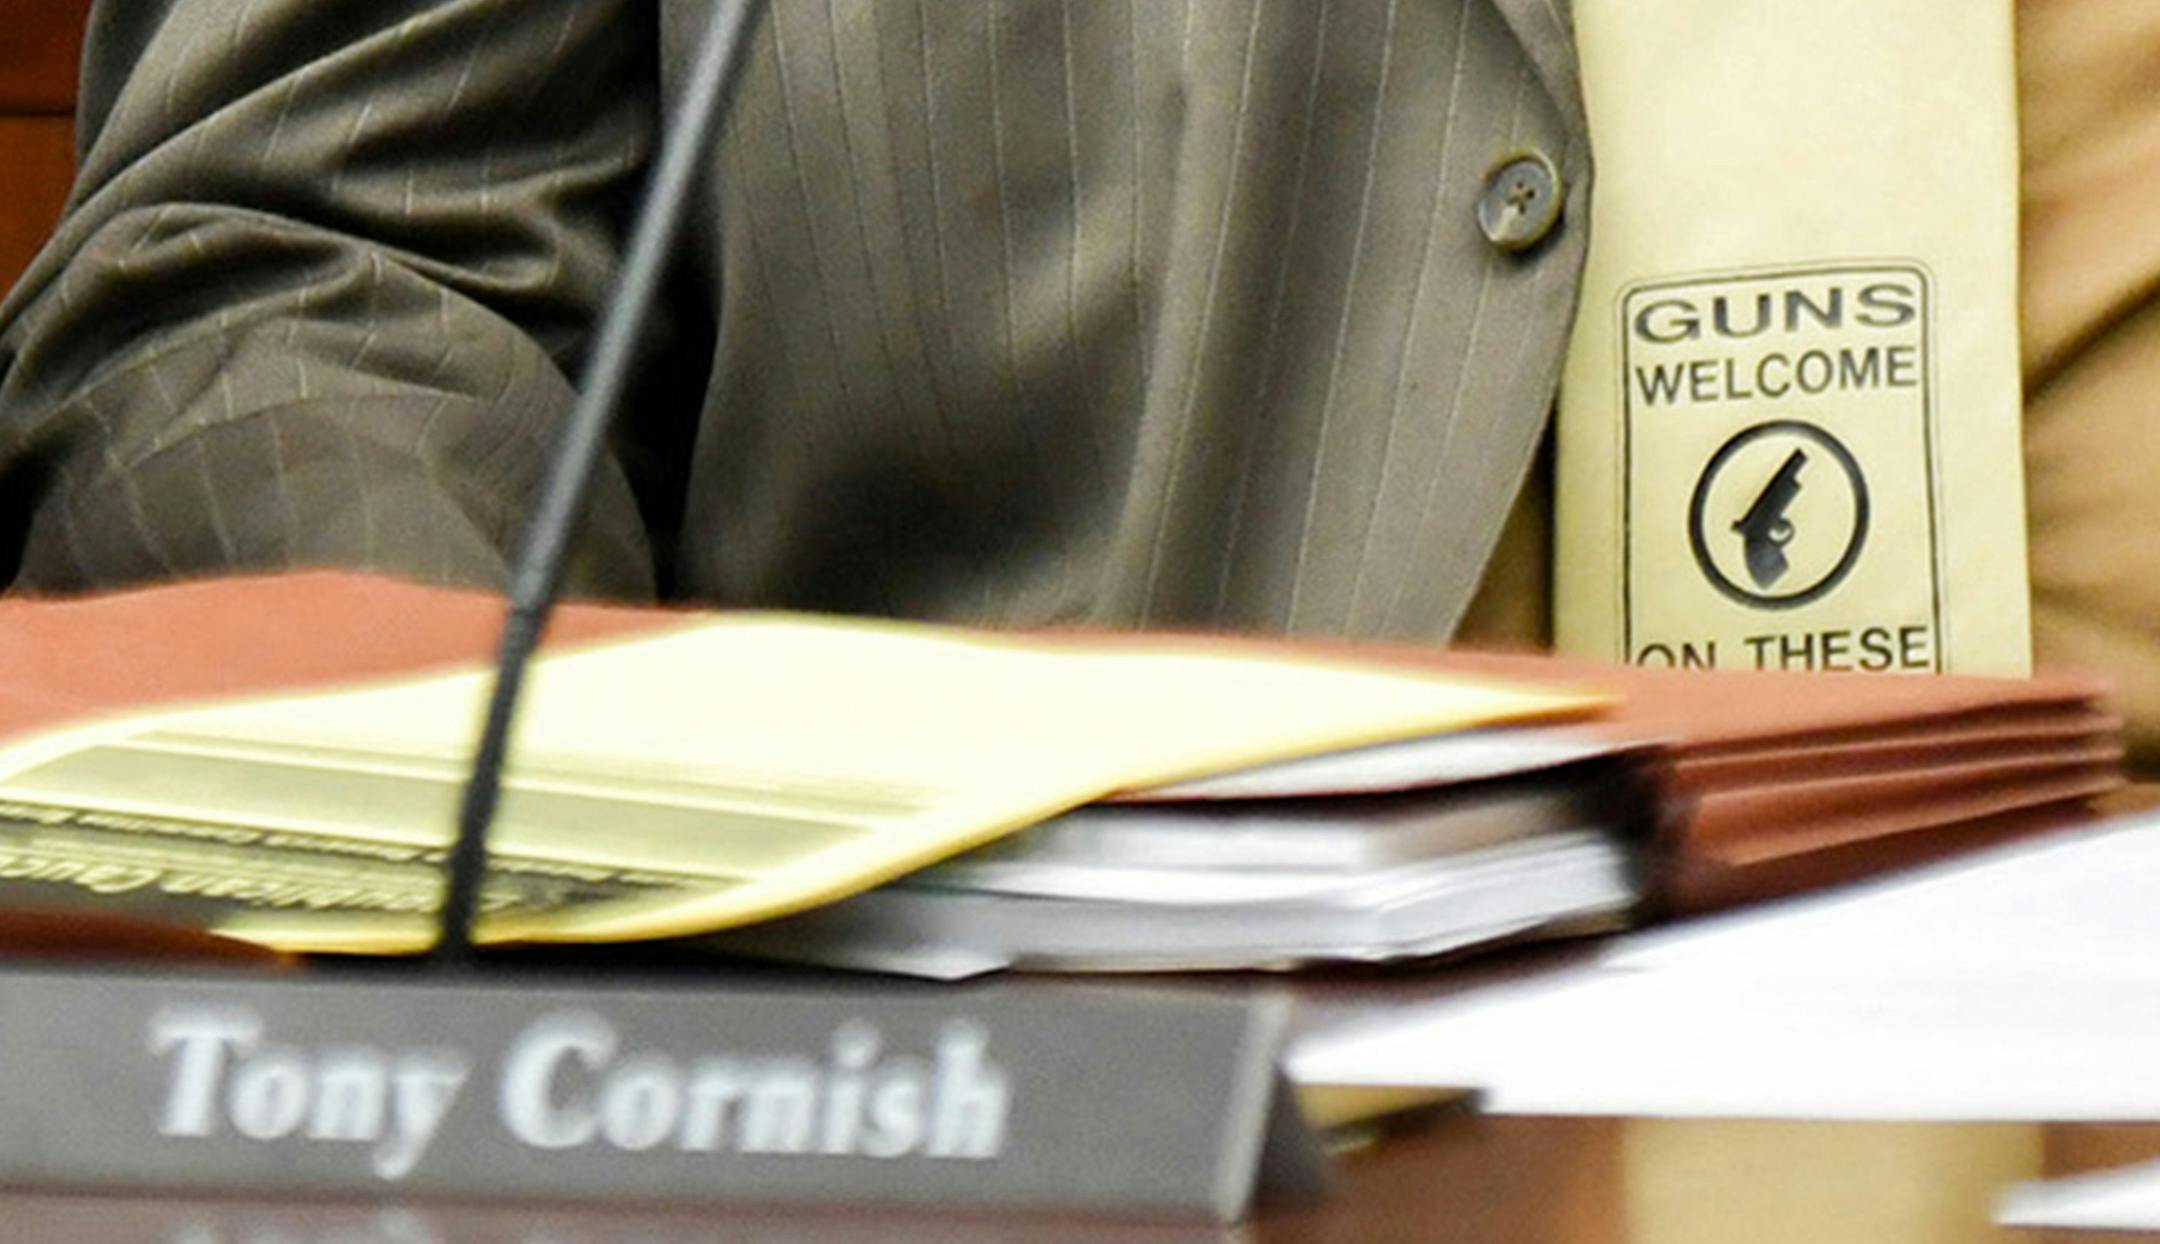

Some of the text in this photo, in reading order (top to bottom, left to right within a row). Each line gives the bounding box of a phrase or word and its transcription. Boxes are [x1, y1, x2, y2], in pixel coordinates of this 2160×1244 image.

[1633, 282, 1916, 344] GUNS
[1634, 345, 1918, 407] WELCOME
[1637, 626, 1930, 672] ON THESE
[147, 1004, 1009, 1181] Tony Cornish
